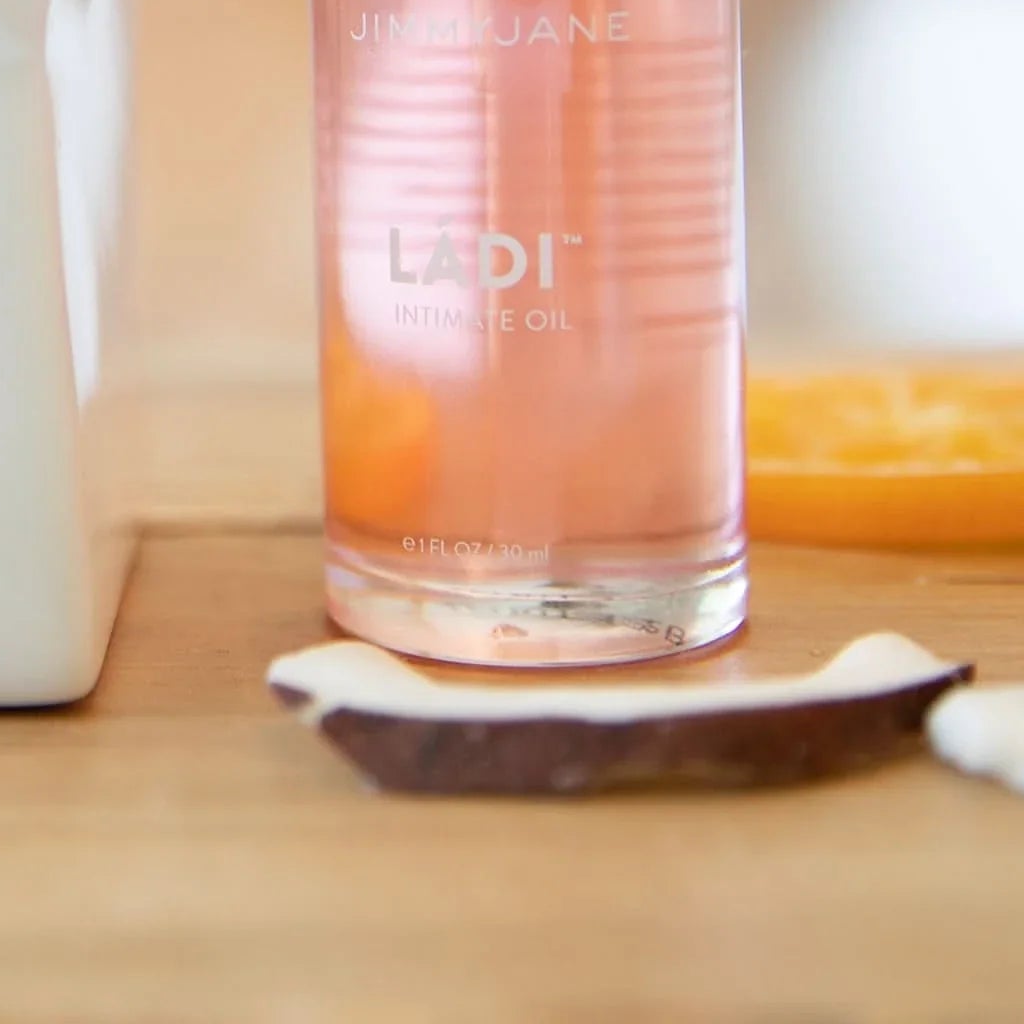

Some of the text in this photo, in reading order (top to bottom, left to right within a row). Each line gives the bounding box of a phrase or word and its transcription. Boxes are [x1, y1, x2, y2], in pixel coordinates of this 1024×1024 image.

[350, 11, 631, 46] JIMMYJANE
[525, 309, 572, 331] OIL
[454, 541, 482, 557] OZ
[499, 544, 522, 559] 30
[528, 543, 549, 561] ml
